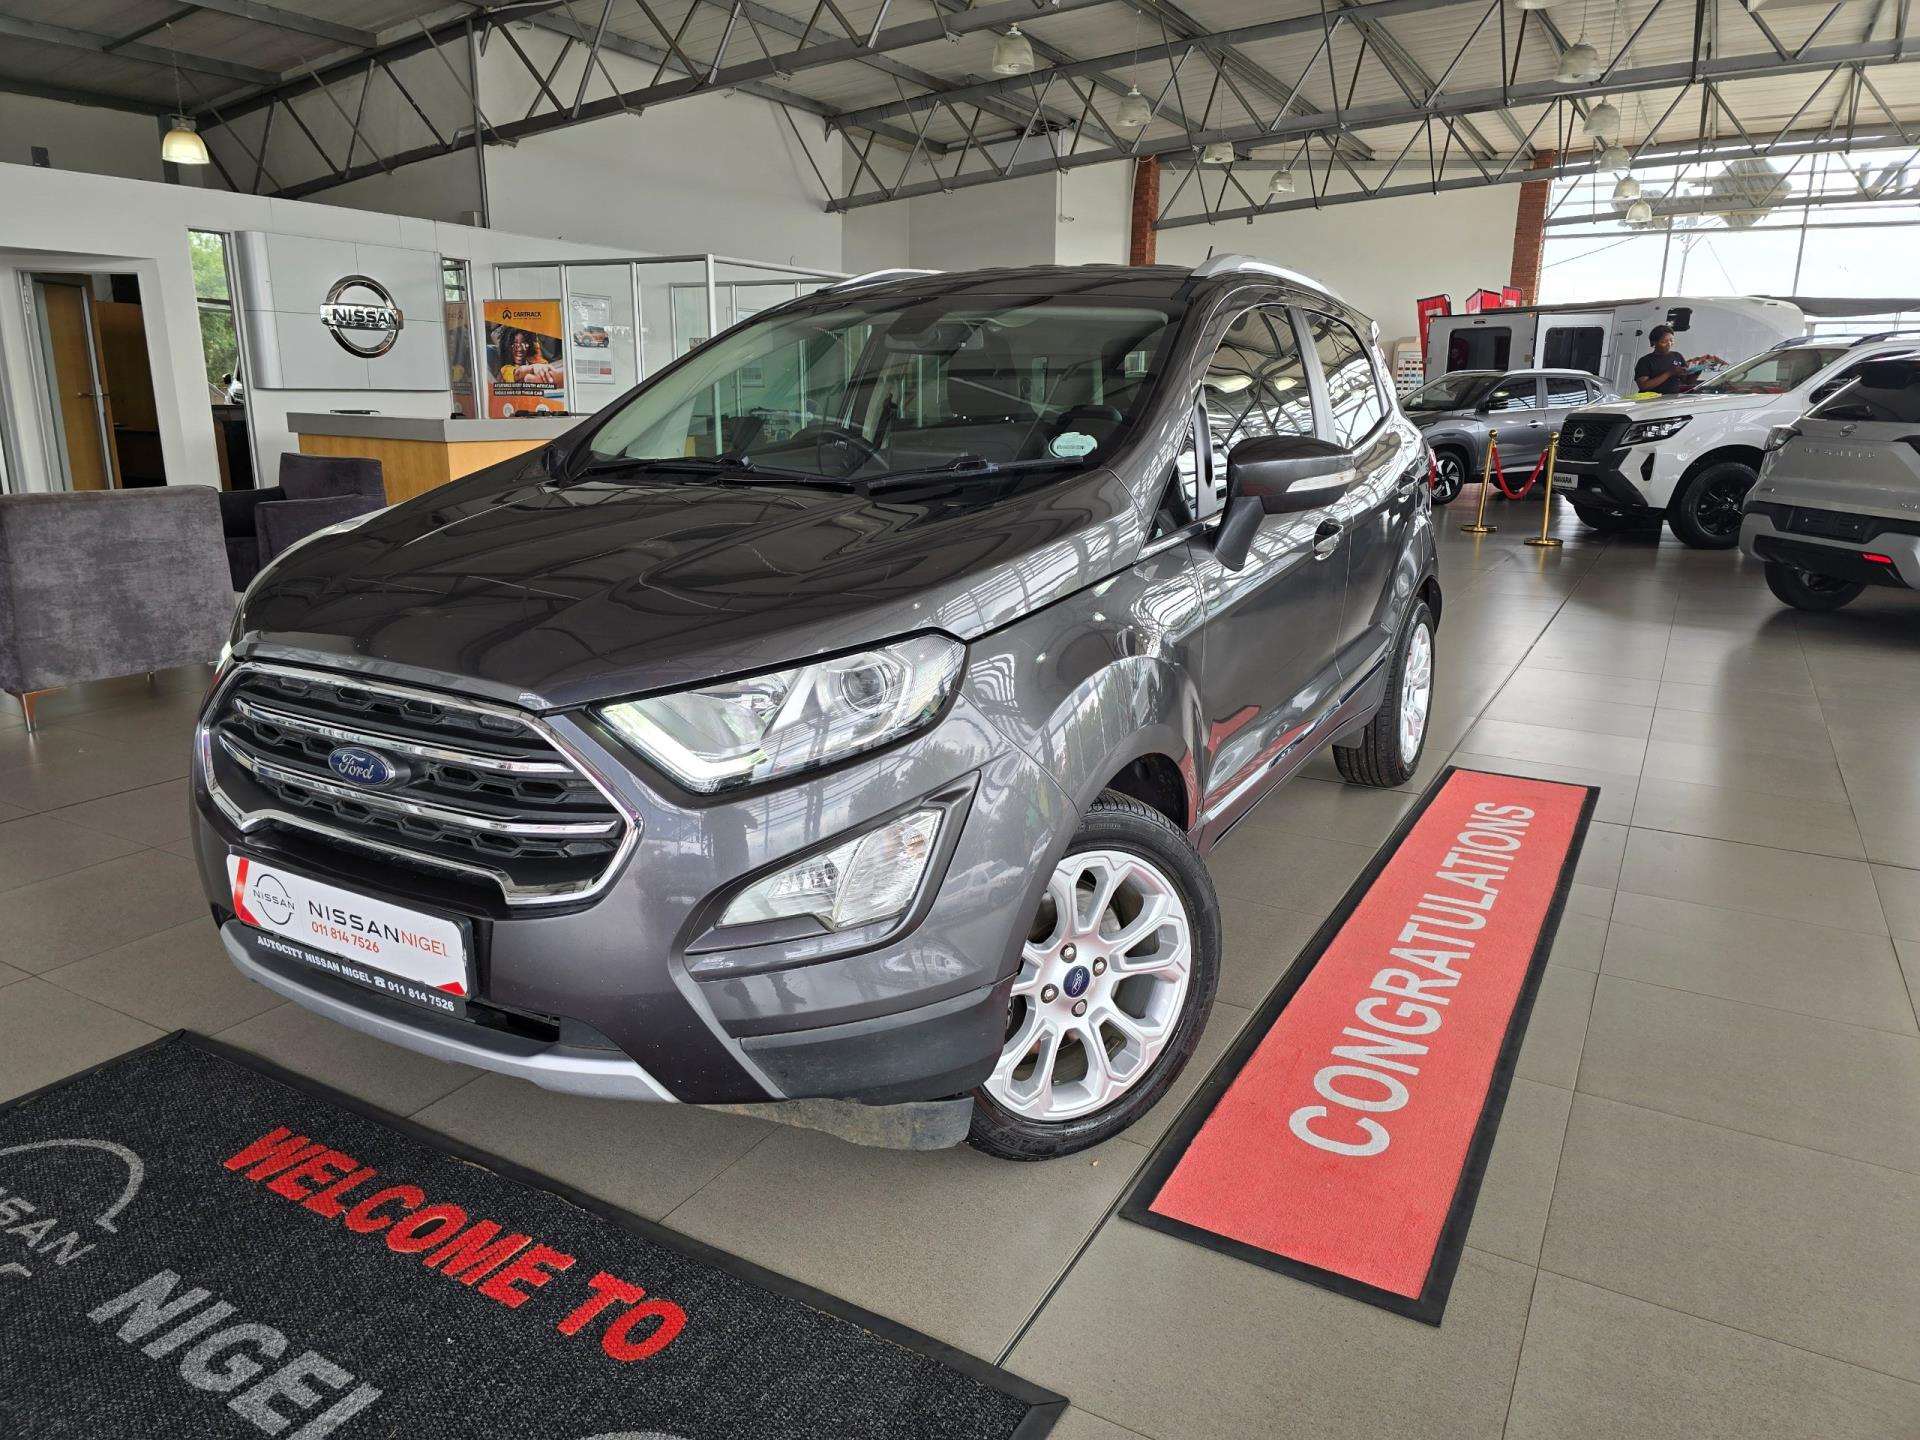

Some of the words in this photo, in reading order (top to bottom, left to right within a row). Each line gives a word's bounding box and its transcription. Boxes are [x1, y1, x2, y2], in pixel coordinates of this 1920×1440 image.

[332, 308, 397, 325] NISSAN
[339, 753, 374, 779] Ford
[253, 889, 295, 910] NISSAN
[311, 921, 328, 936] 011
[331, 927, 349, 944] 814
[351, 934, 380, 953] 7526
[257, 935, 303, 959] AUTOCITY
[305, 953, 341, 973] NISSAN
[341, 965, 372, 984] NIGEL
[388, 981, 406, 995] 011
[408, 988, 427, 1003] 814
[428, 994, 455, 1012] 7526
[1289, 802, 1535, 1157] CONGRATULATIONS
[223, 1126, 575, 1309] WELCOME
[557, 1271, 688, 1363] TO
